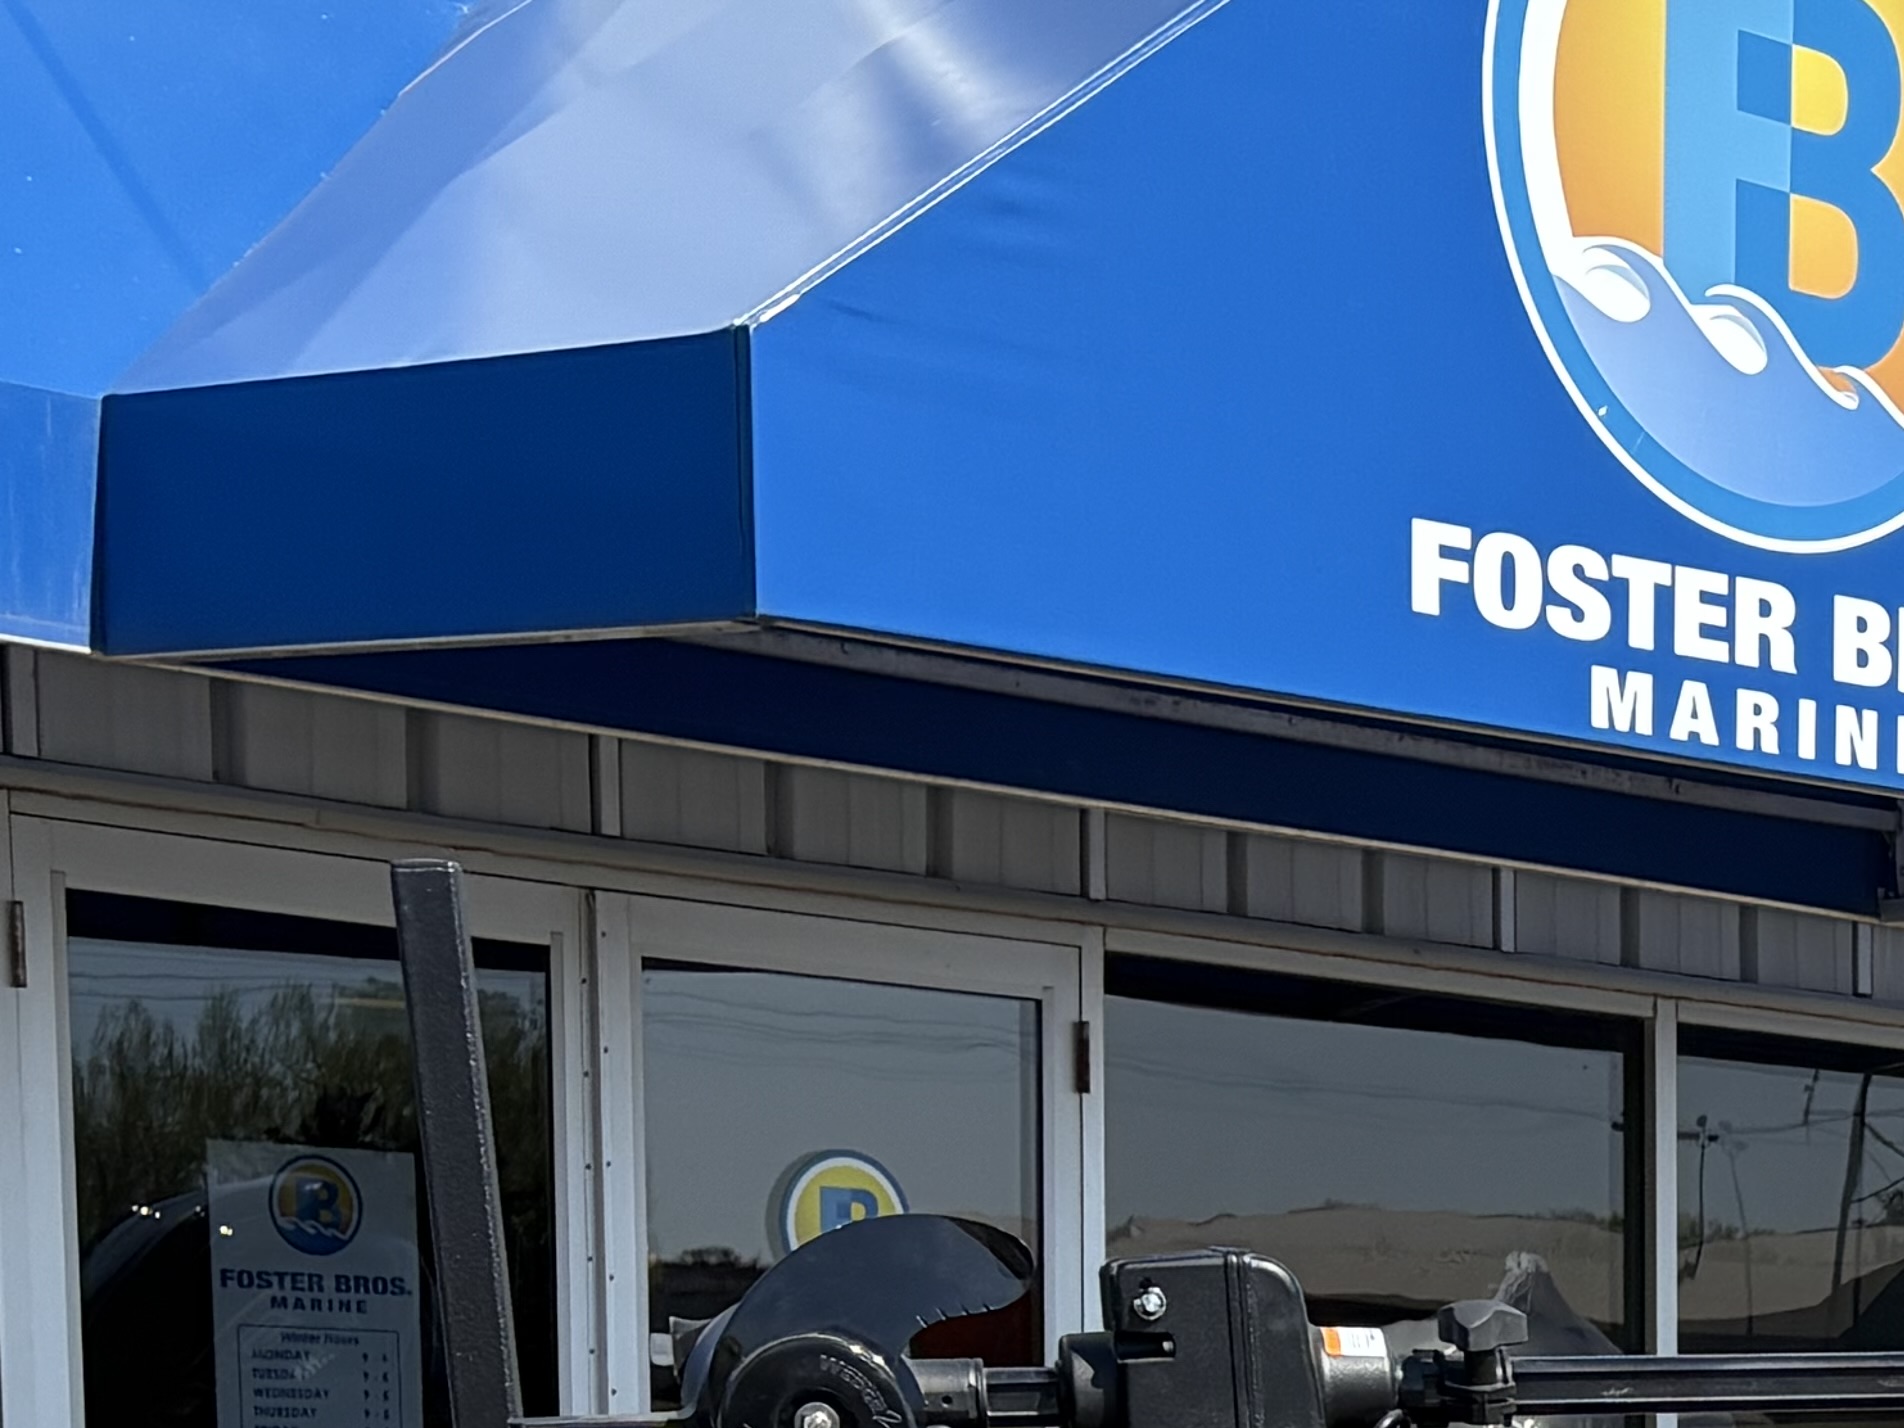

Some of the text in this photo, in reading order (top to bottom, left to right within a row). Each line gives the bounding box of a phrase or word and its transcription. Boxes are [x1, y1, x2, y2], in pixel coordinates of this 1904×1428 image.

[1411, 516, 1798, 675] FOSTER
[219, 1267, 413, 1297] FOSTER BROS.
[270, 1295, 368, 1314] MARINE
[251, 1348, 311, 1361] MONDAY
[253, 1387, 330, 1400] WEDNESDAY
[253, 1404, 317, 1418] THURSDAY
